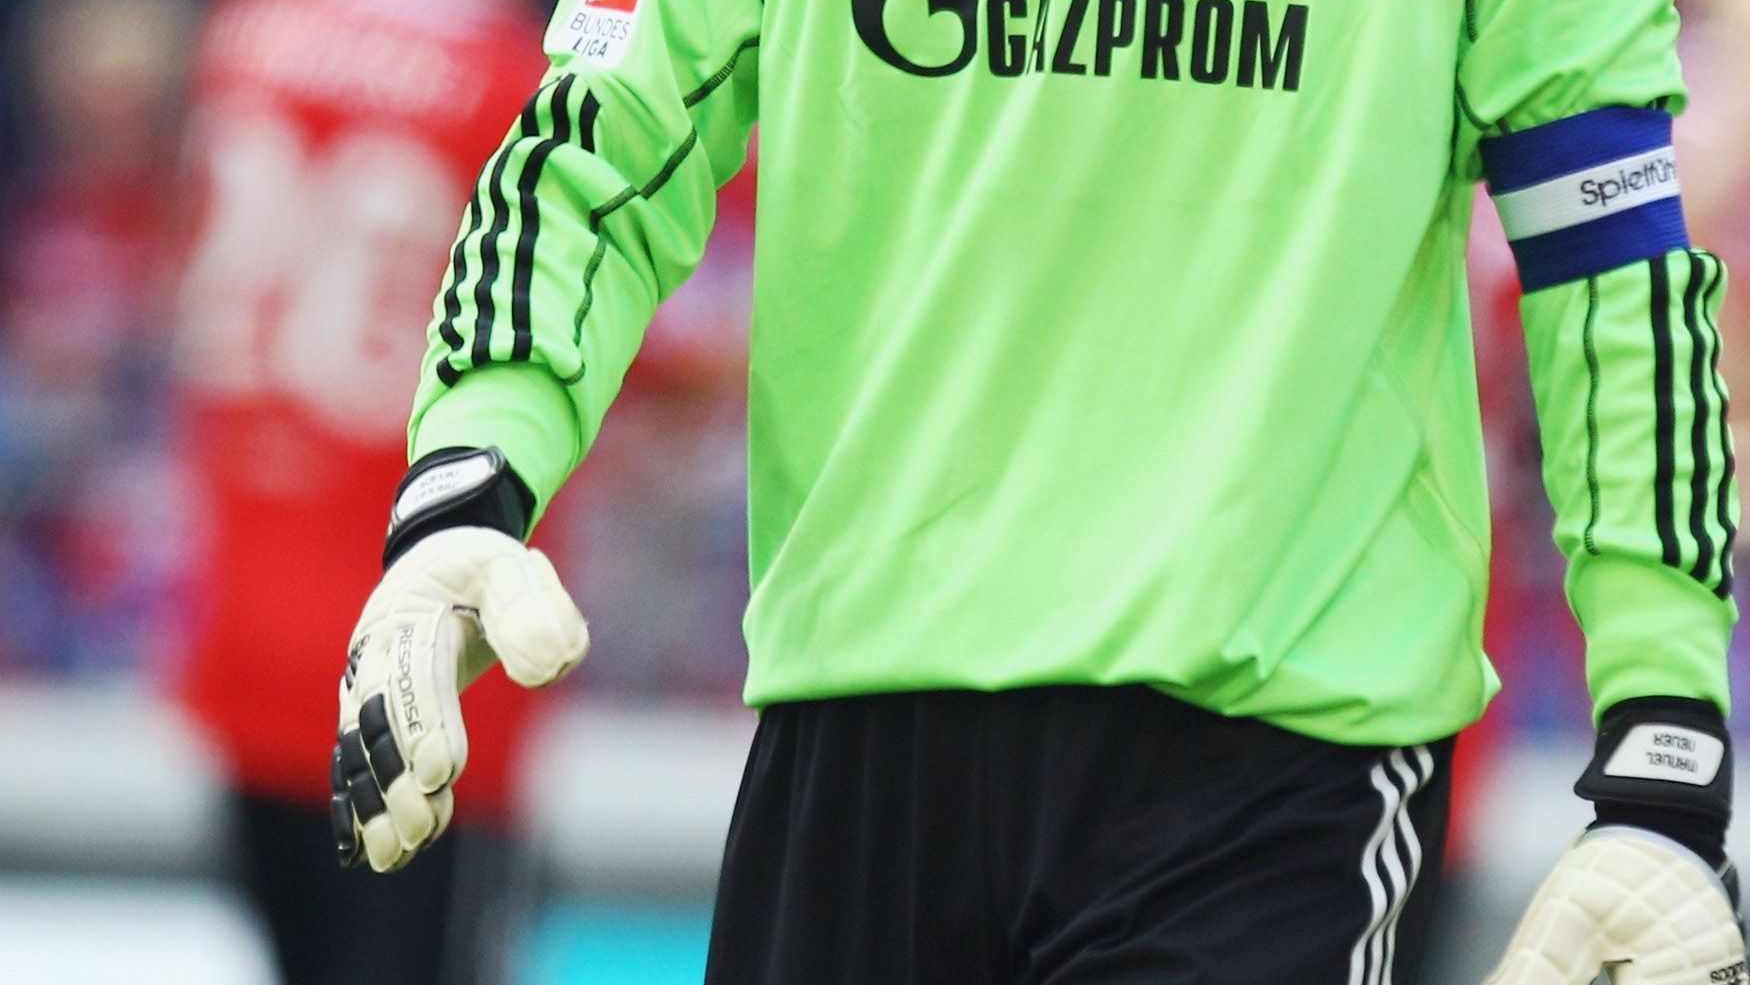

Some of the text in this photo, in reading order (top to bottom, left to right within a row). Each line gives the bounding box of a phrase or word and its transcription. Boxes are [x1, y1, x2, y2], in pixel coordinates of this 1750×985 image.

[570, 12, 630, 40] BUNDES
[572, 38, 608, 58] LIGA
[398, 625, 423, 735] RESPONSE
